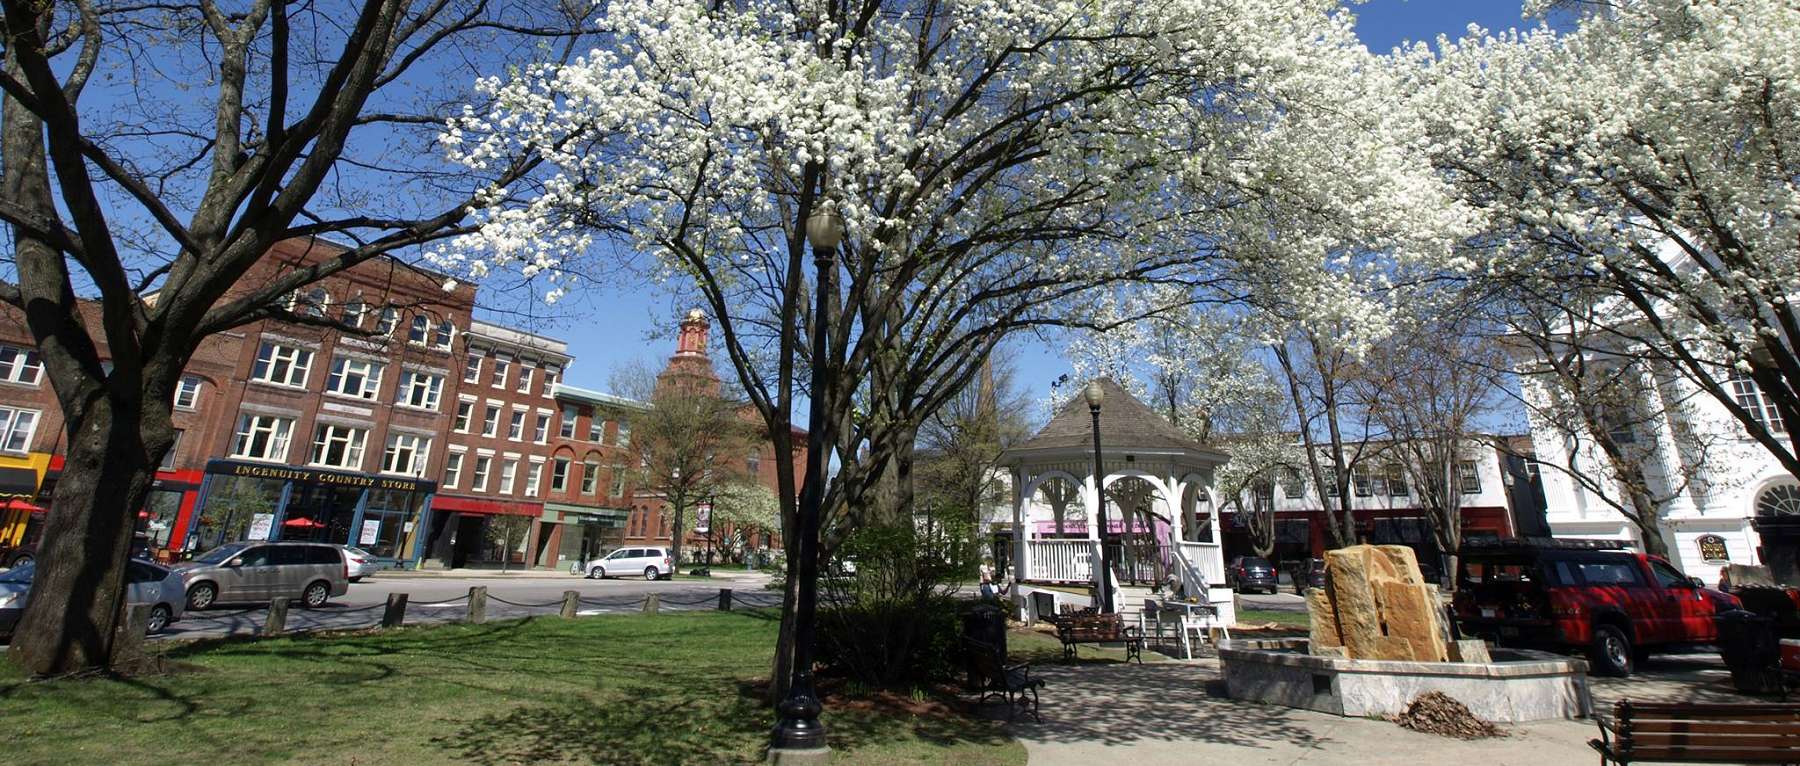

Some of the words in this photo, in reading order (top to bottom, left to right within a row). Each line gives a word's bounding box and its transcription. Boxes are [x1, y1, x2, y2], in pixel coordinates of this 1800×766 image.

[235, 465, 311, 480] INGENUITY
[319, 473, 375, 486] COUNTRY
[381, 479, 417, 490] STORE
